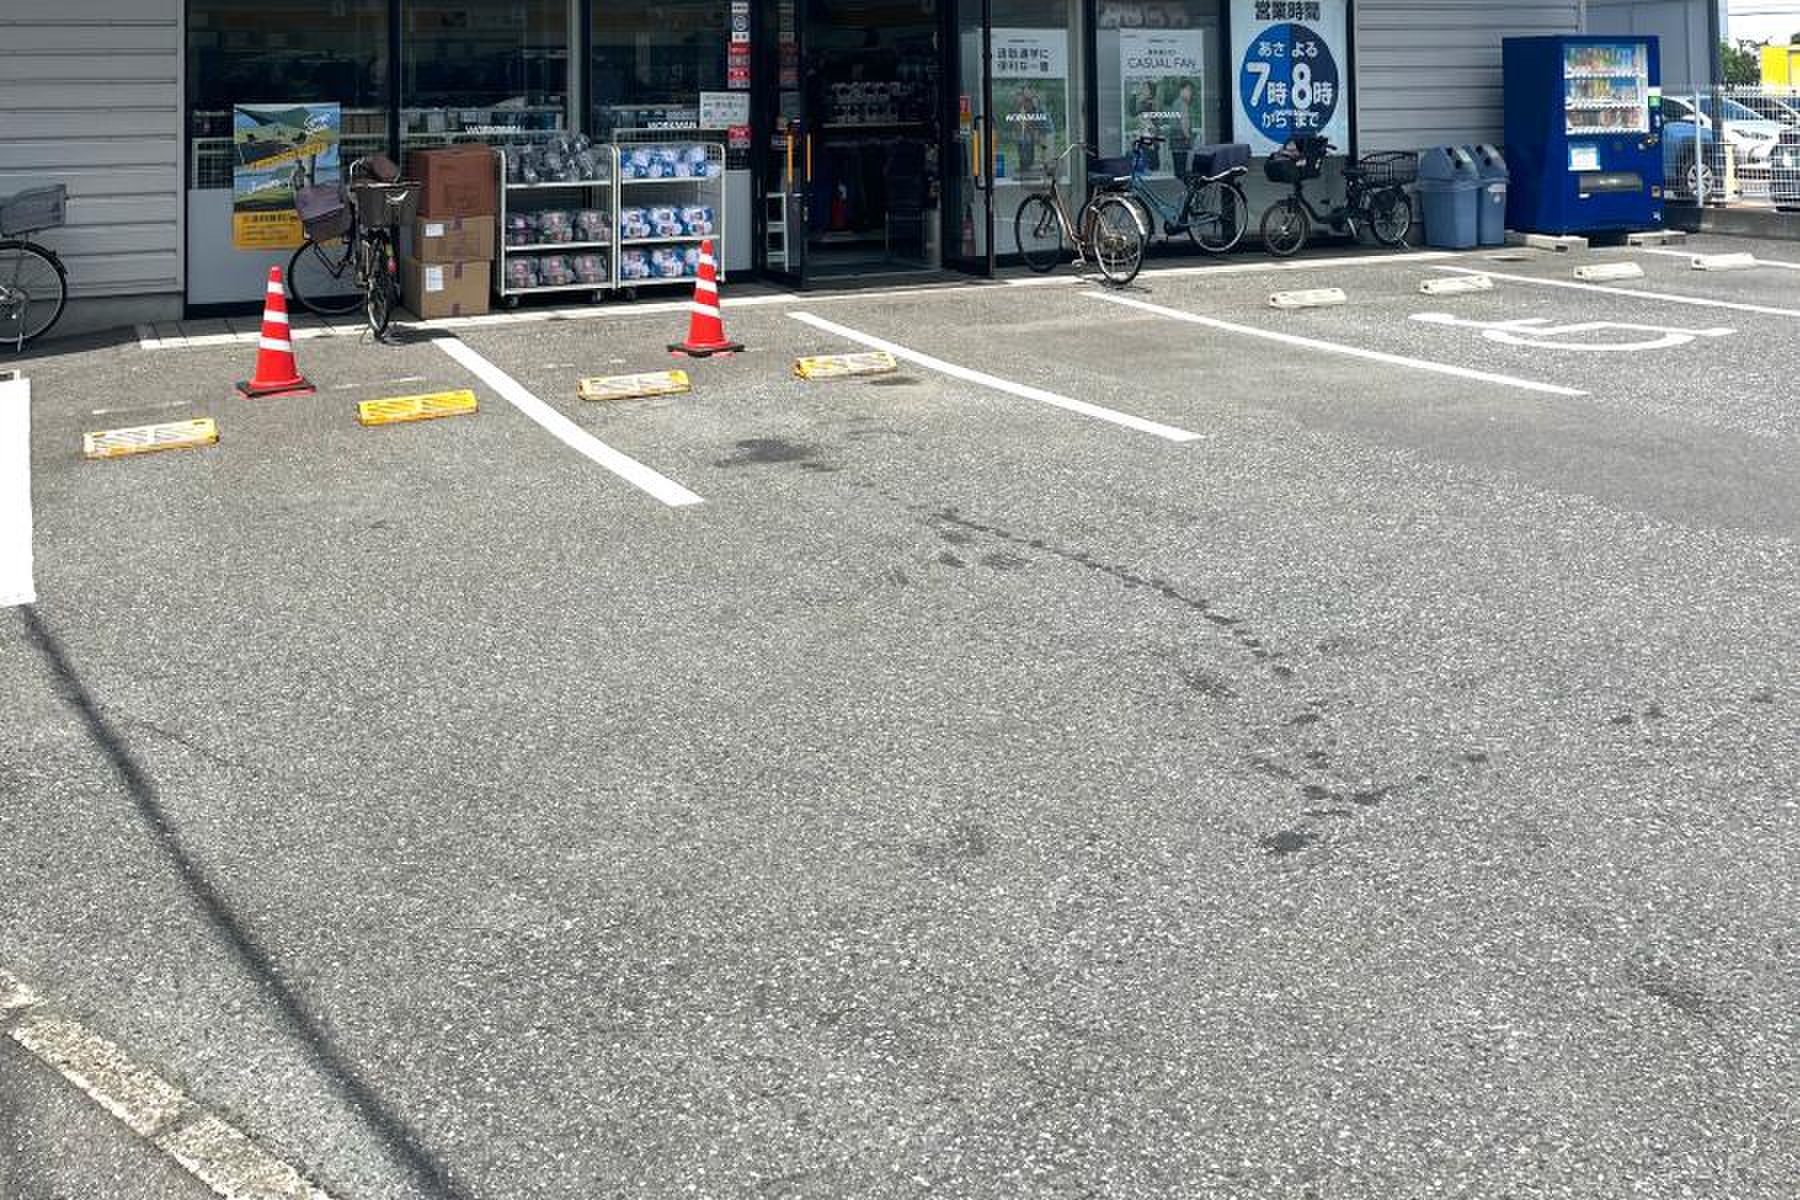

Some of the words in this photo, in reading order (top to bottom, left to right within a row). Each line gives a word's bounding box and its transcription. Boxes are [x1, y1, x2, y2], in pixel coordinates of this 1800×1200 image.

[1254, 0, 1321, 22] 営業時間
[1257, 41, 1286, 58] あさ
[1291, 41, 1319, 58] よる
[1128, 57, 1172, 69] CASUAL
[1174, 57, 1197, 69] FAN
[1246, 61, 1288, 107] 7時
[1291, 63, 1333, 109] 8時
[1261, 111, 1288, 128] から
[1294, 111, 1320, 128] まで
